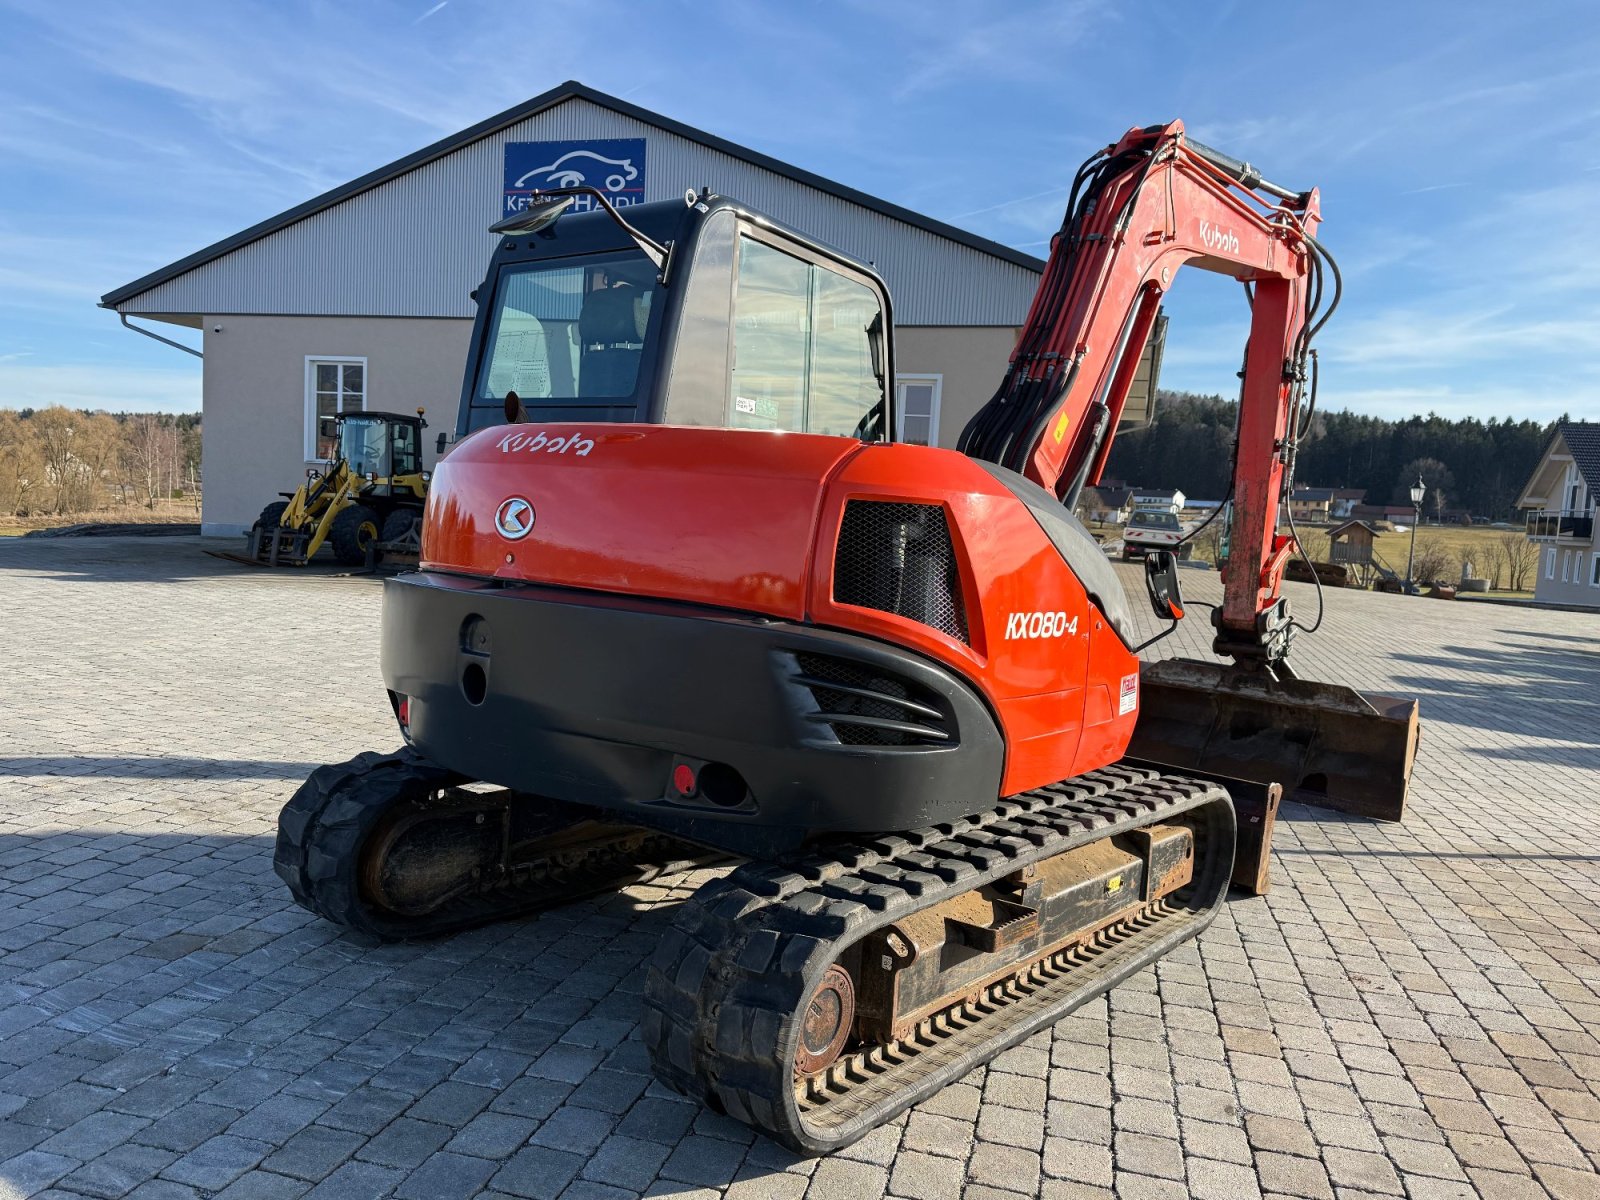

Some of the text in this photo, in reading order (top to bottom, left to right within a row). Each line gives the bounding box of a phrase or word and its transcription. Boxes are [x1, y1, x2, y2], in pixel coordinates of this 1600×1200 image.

[1199, 220, 1239, 256] Kubota
[496, 431, 595, 456] Kubota
[1004, 611, 1079, 640] KX080-4
